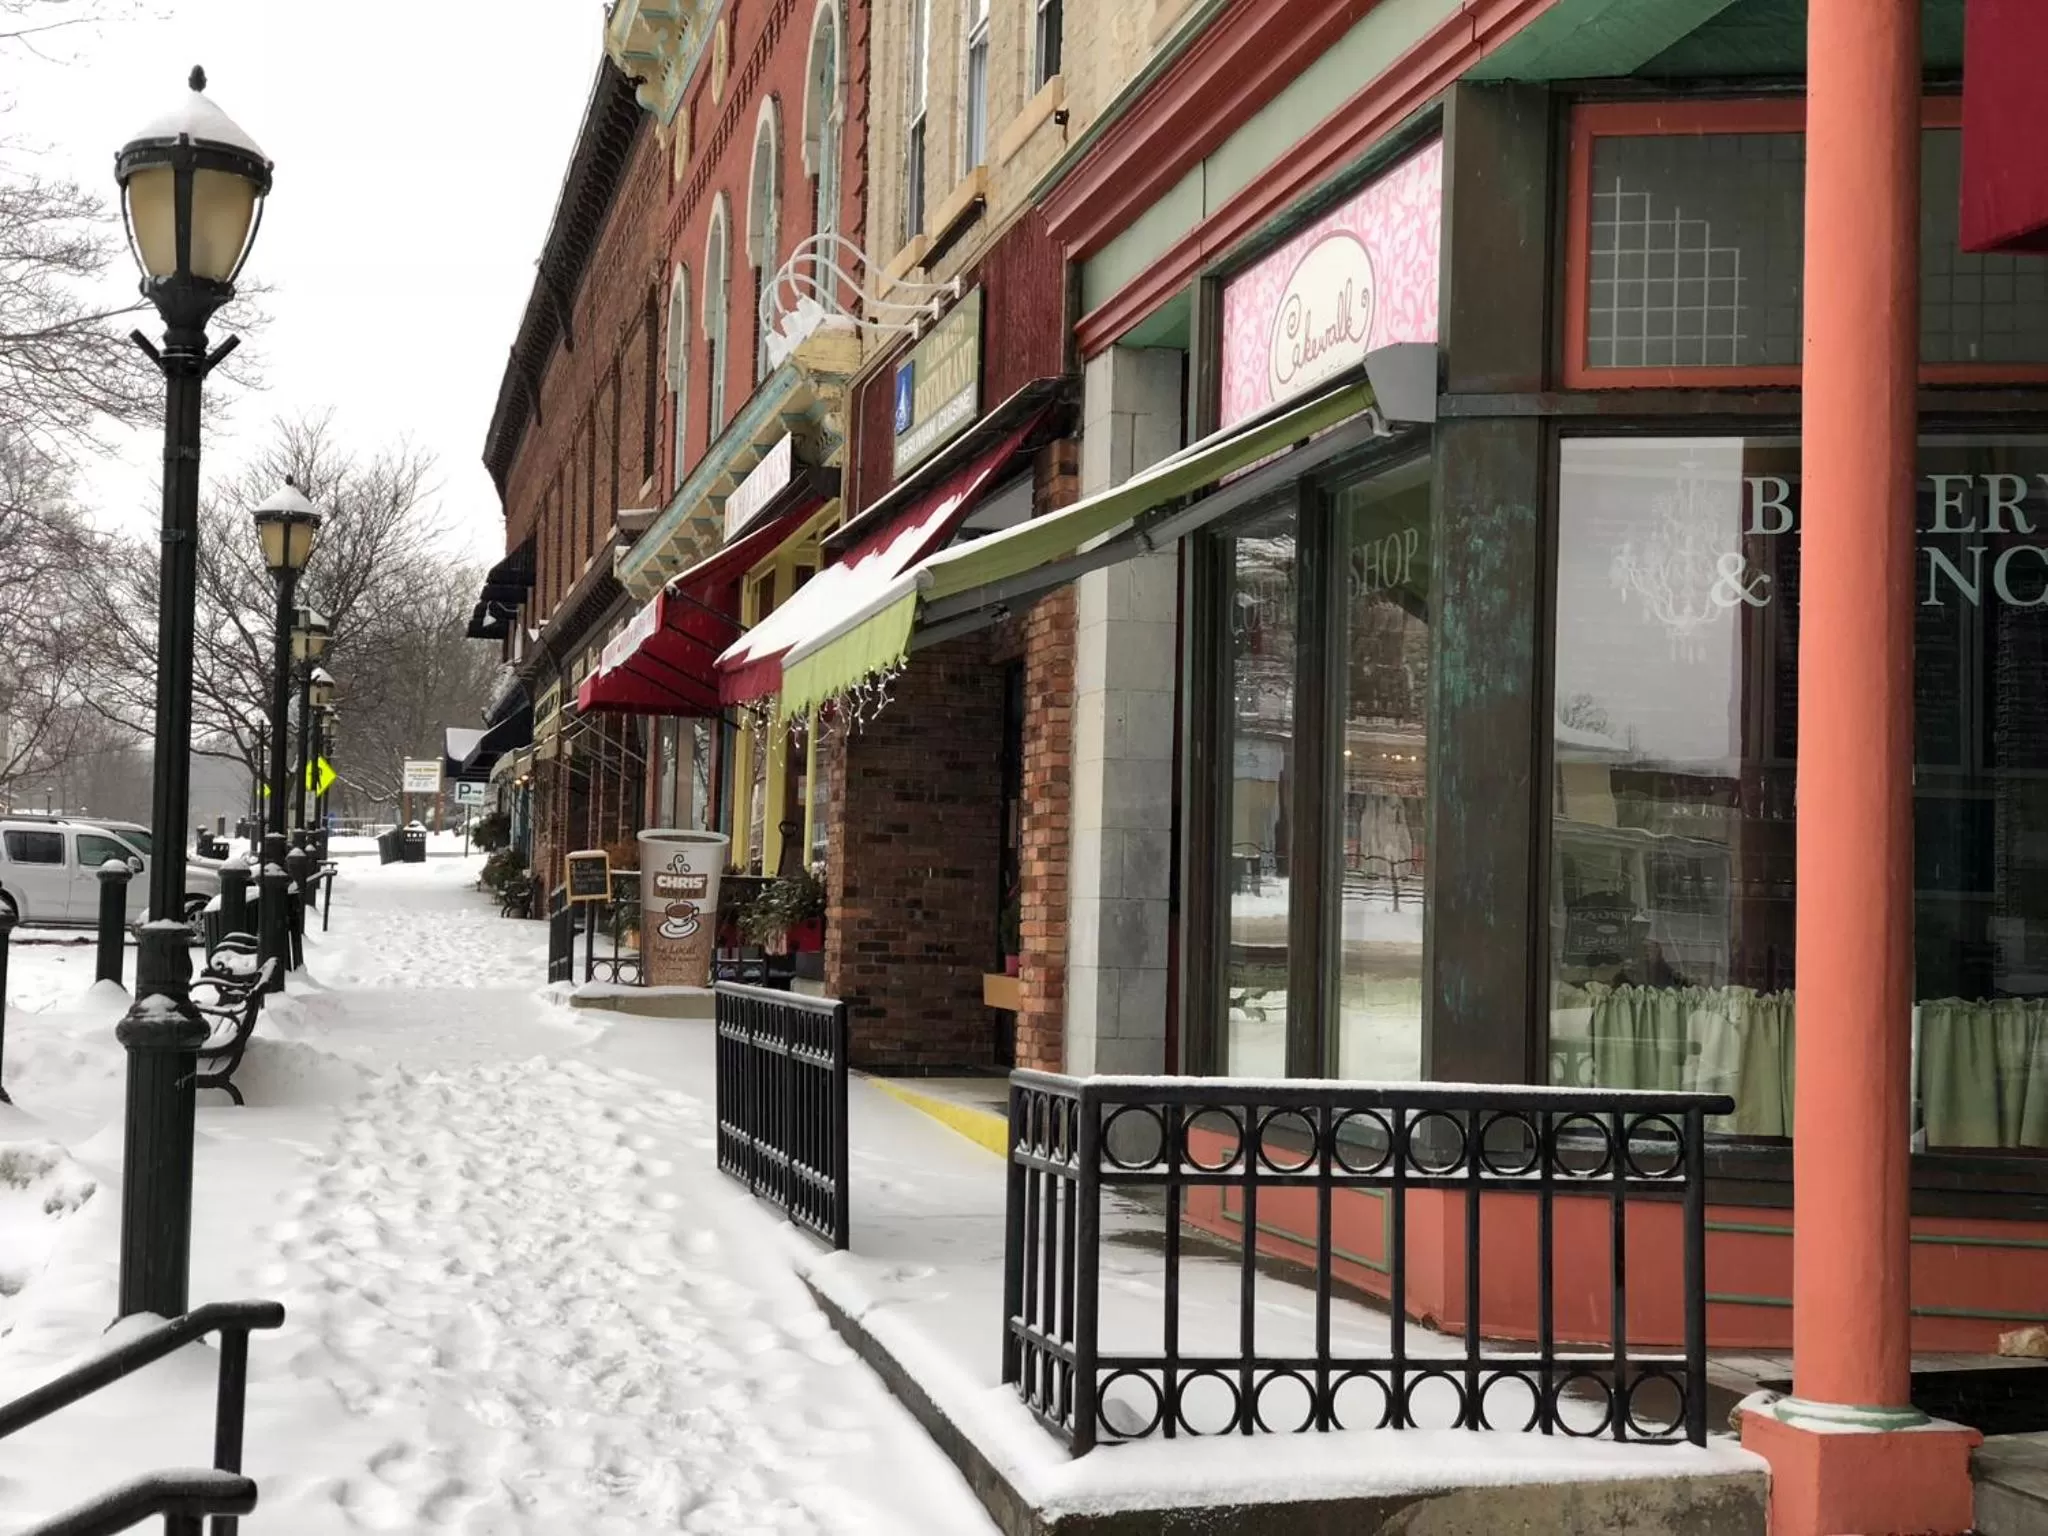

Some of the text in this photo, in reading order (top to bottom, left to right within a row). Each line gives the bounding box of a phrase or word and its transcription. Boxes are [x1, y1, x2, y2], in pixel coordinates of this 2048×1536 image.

[1275, 277, 1370, 385] Cakewalk
[1743, 473, 2048, 535] BER
[1347, 526, 1419, 600] SHOP
[458, 783, 471, 800] P
